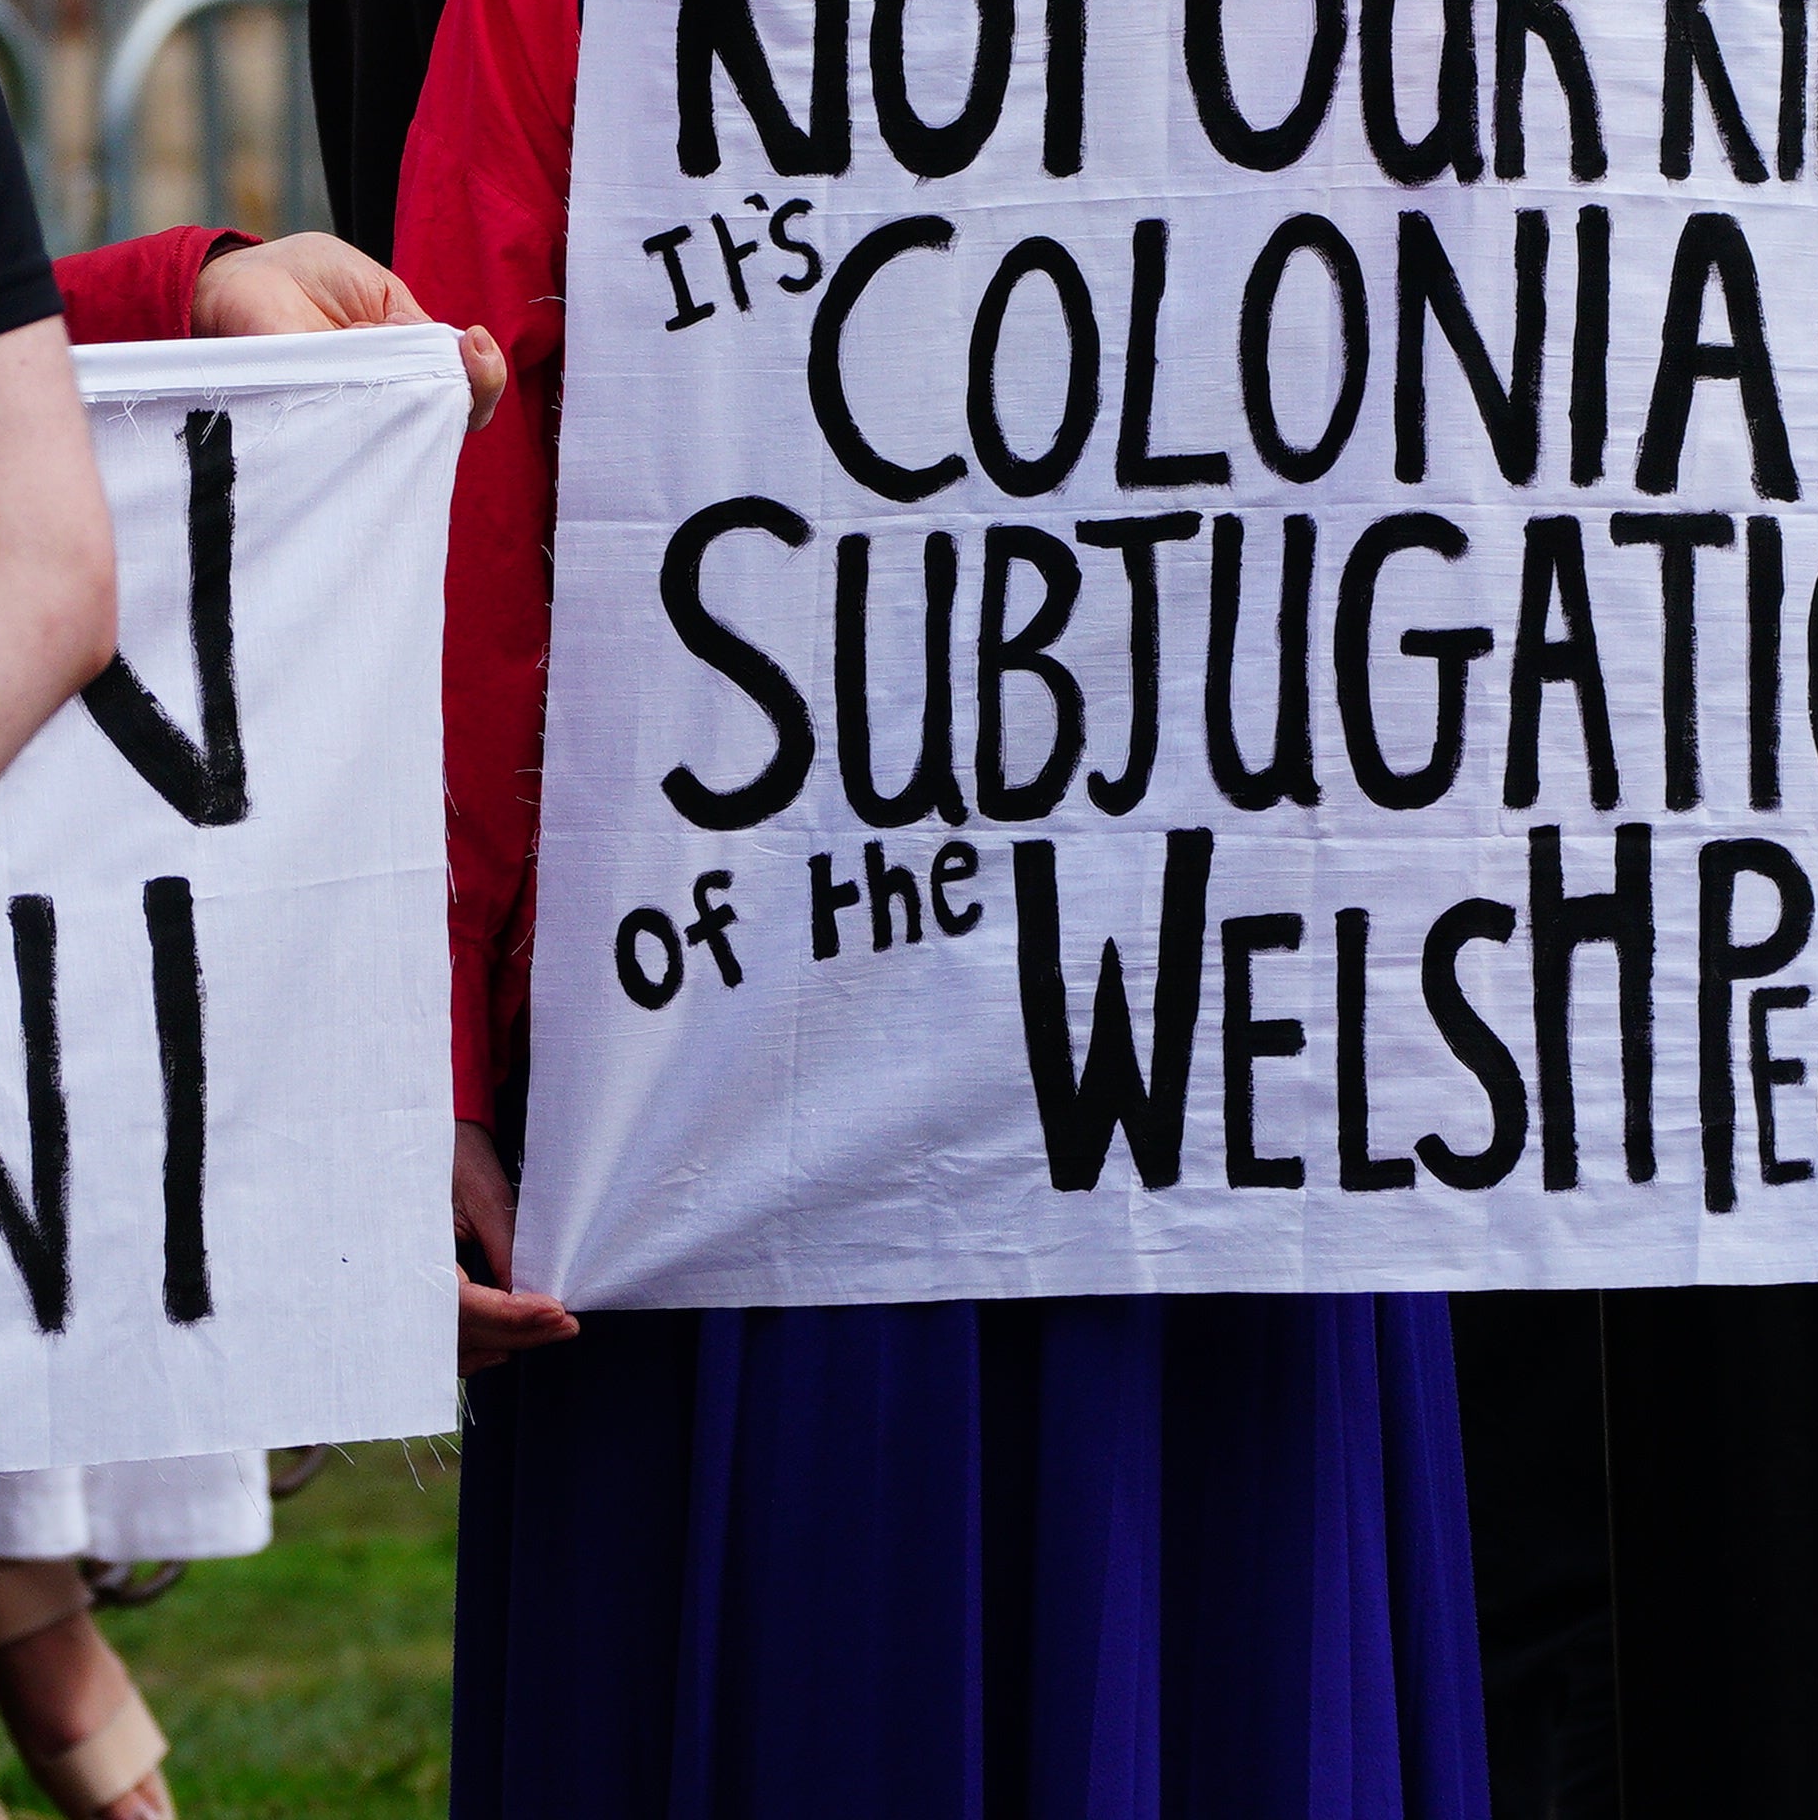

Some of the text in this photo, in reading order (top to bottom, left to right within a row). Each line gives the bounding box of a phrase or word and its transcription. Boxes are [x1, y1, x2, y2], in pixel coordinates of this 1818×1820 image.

[612, 868, 747, 1014] of
[806, 839, 985, 963] the
[1011, 821, 1659, 1194] WELSH
